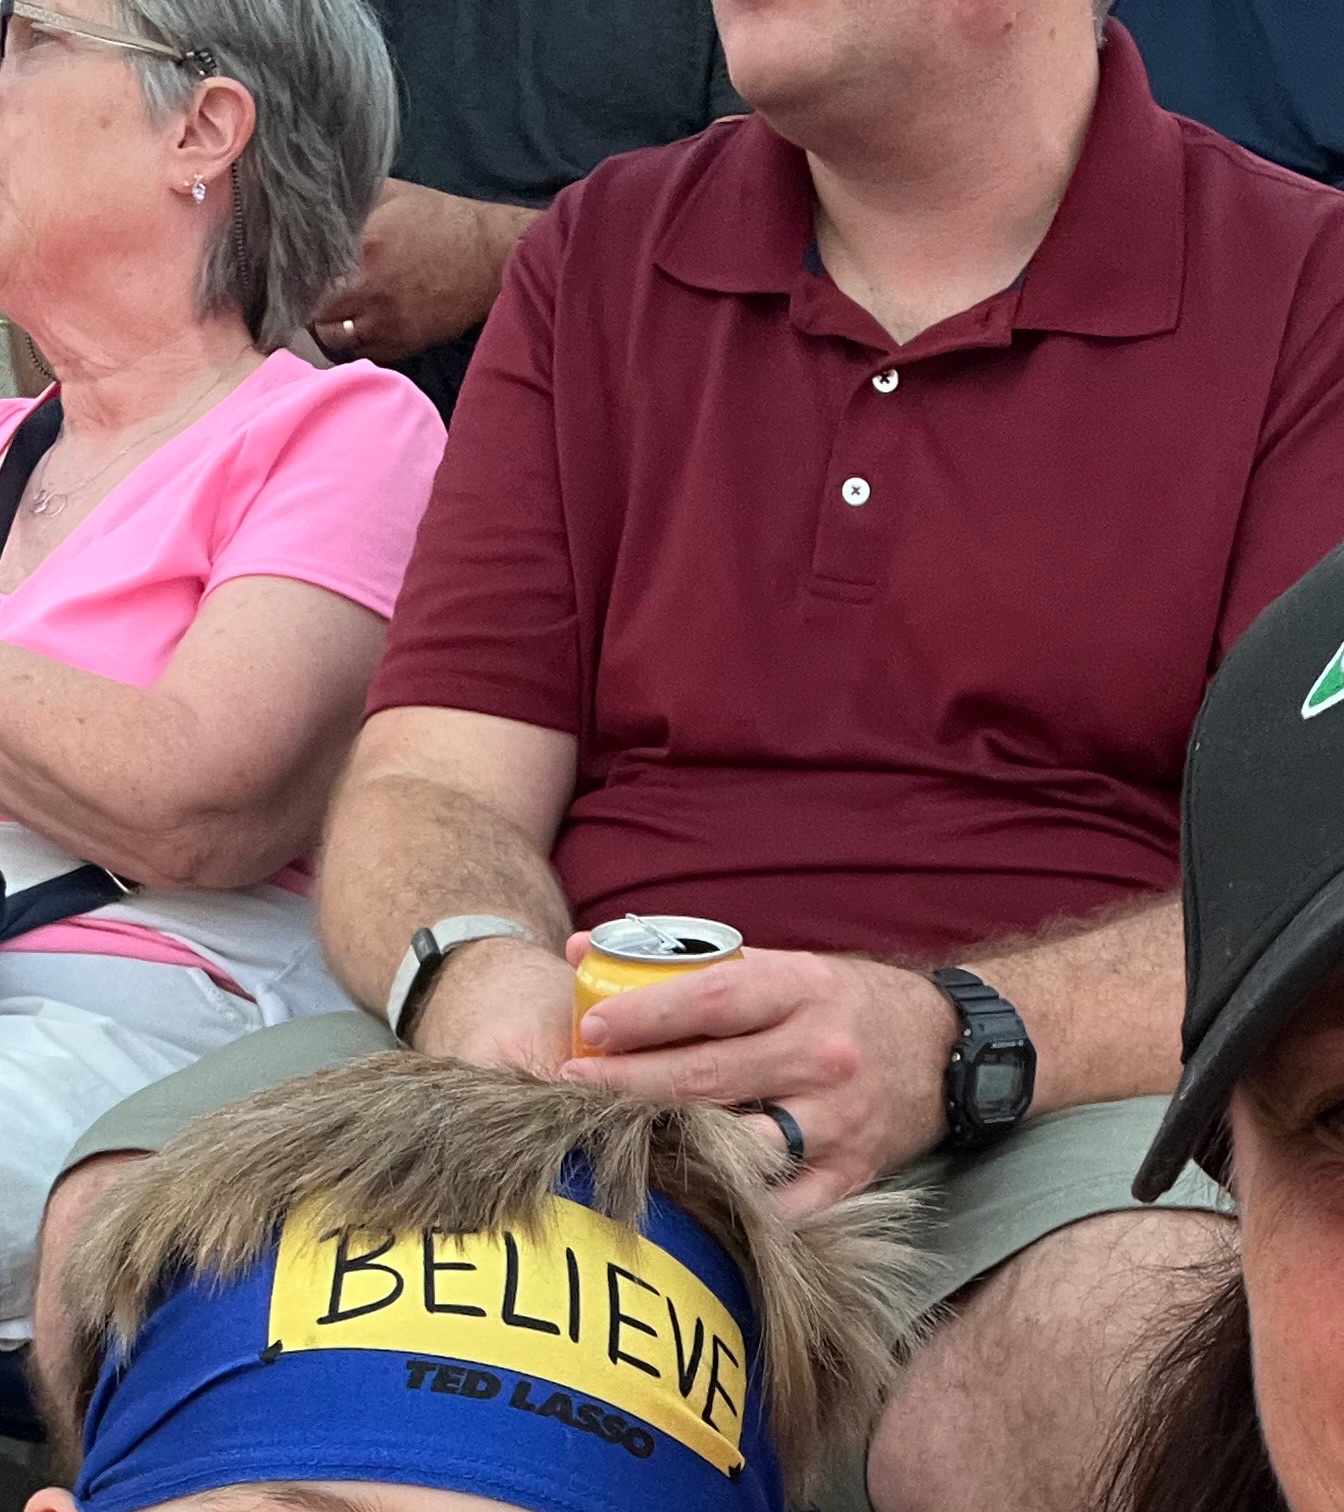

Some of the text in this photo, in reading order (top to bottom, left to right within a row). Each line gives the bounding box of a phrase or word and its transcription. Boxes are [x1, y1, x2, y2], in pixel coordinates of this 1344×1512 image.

[316, 1226, 742, 1432] BELIEVE
[406, 1360, 656, 1460] TED LASSO
